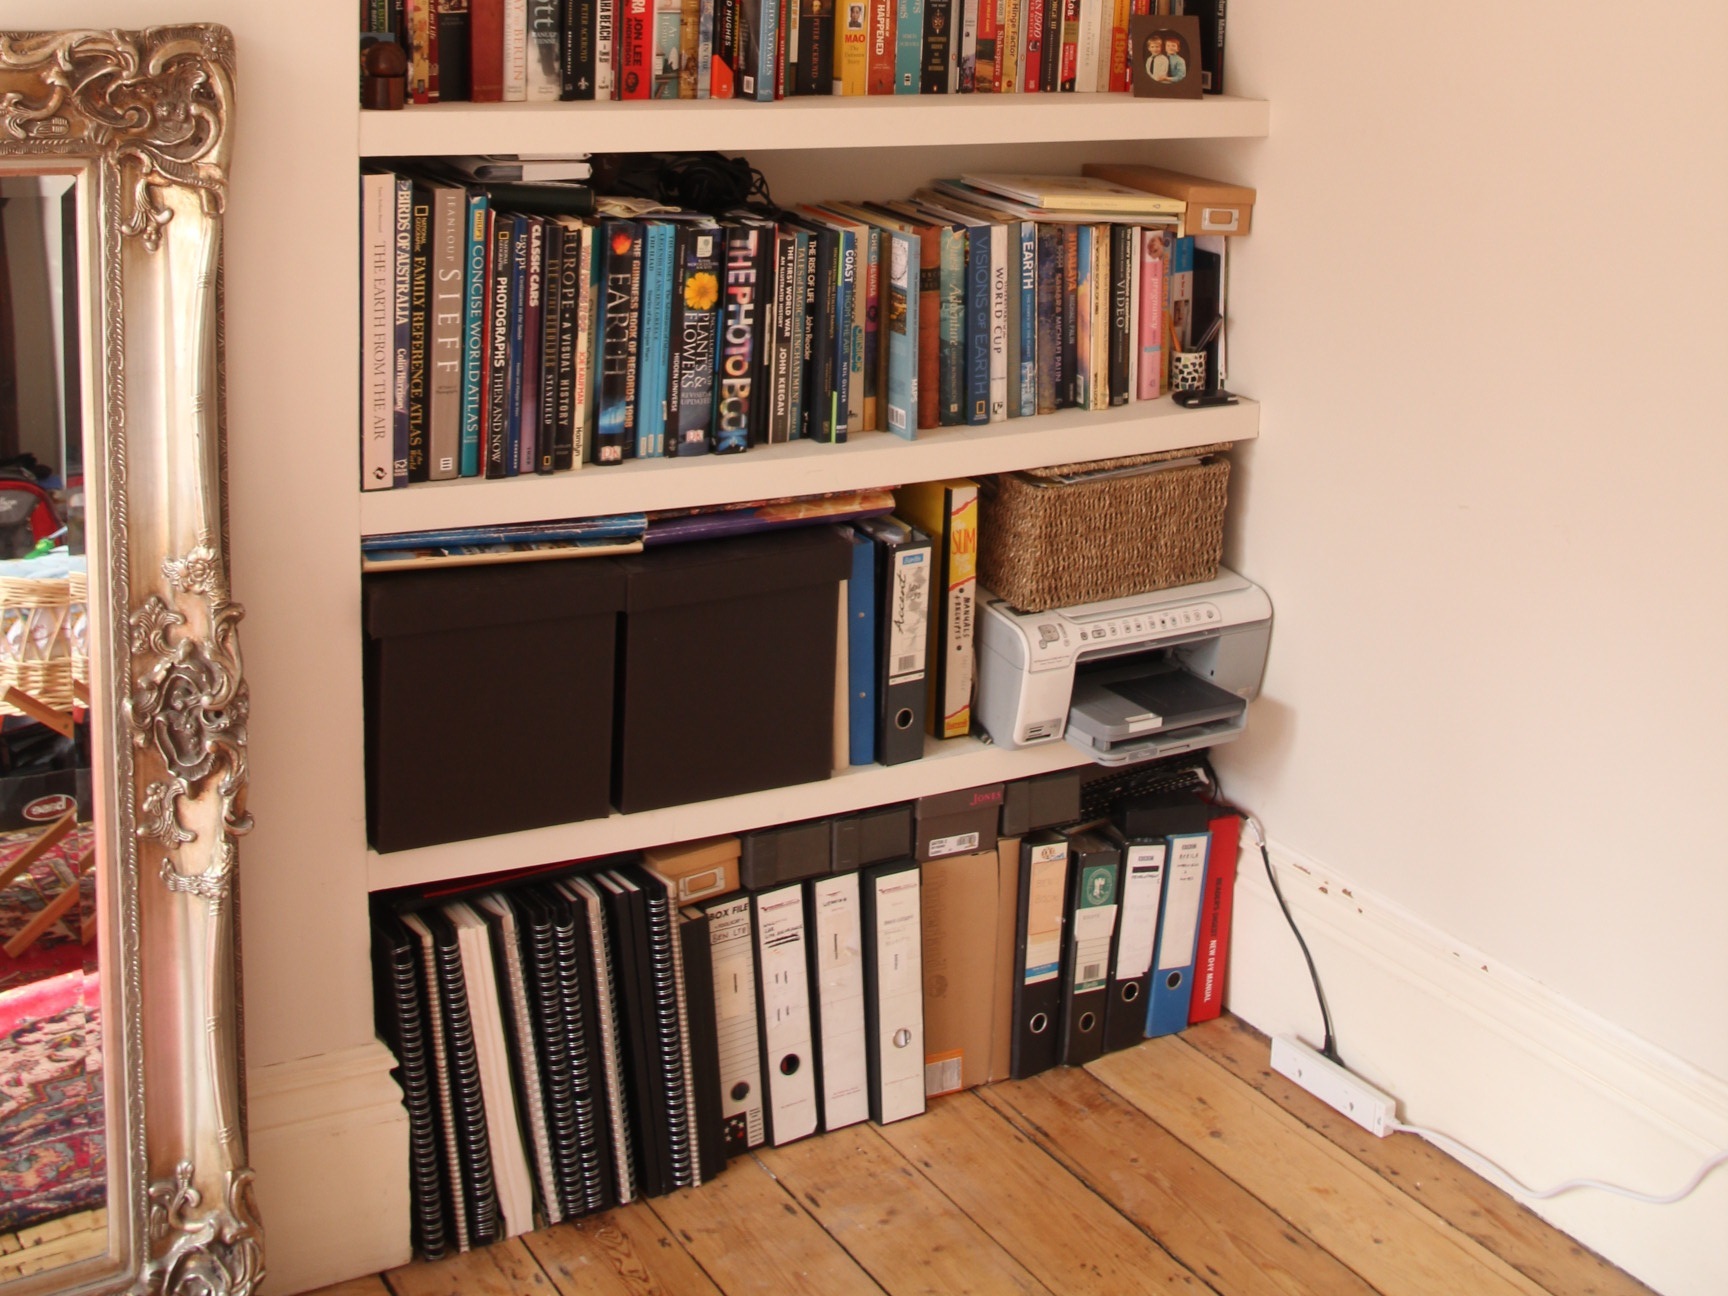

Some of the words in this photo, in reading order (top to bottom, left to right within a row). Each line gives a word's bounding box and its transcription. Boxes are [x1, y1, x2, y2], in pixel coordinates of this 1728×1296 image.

[580, 3, 589, 24] PETER
[599, 14, 612, 41] BEACH
[633, 17, 643, 40] JON
[724, 9, 733, 46] HUGHES
[876, 4, 885, 55] HAPPENED
[1009, 3, 1018, 29] Hinge
[1033, 11, 1043, 38] 1900
[580, 27, 589, 62] ACKROYD
[625, 17, 633, 66] ANDERSON
[845, 34, 866, 43] MAO
[1009, 31, 1017, 57] Factor
[1217, 19, 1225, 47] Makers
[633, 44, 642, 66] LEE
[994, 31, 1004, 76] Shakespeare
[396, 190, 410, 230] BIRDS
[396, 234, 409, 250] OF
[445, 196, 456, 262] JEANLOUP
[373, 242, 386, 274] THE
[515, 234, 527, 270] Egypt
[530, 225, 541, 273] CLASSIC
[808, 240, 817, 254] THE
[561, 231, 577, 310] EUROPE
[785, 263, 794, 284] FIRST
[807, 274, 816, 287] OF
[808, 255, 816, 273] RISE
[844, 249, 855, 283] COAST
[975, 236, 989, 309] VISIONS
[1023, 241, 1034, 289] EARTH
[395, 250, 409, 326] AUSTRALIA
[412, 256, 426, 308] FAMILY
[470, 245, 484, 318] CONCISE
[529, 274, 540, 307] CARS
[806, 288, 815, 303] LIFE
[994, 267, 1004, 319] WORLD
[373, 278, 386, 328] EARTH
[784, 286, 792, 316] WORLD
[843, 290, 852, 318] FROM
[1116, 280, 1126, 328] VIDEO
[437, 269, 461, 373] SIEFF
[494, 277, 507, 368] PHOTOGRAPHS
[604, 273, 631, 375] EARTH
[783, 318, 791, 337] WAR
[805, 315, 814, 332] John
[843, 320, 852, 337] THE
[976, 312, 986, 329] OF
[373, 333, 386, 376] FROM
[410, 311, 425, 398] REFERENCE
[468, 322, 481, 381] WORLD
[560, 334, 571, 374] VISUAL
[681, 312, 697, 388] FLOWERS
[695, 312, 709, 371] PLANTS
[804, 333, 813, 360] Reader
[842, 337, 852, 354] AIR
[993, 325, 1003, 354] CUP
[396, 348, 407, 371] Colin
[672, 353, 680, 378] HIDDEN
[778, 347, 787, 375] JOHN
[974, 334, 989, 394] EARTH
[396, 371, 406, 410] Harrison
[492, 370, 504, 401] THEN
[671, 379, 679, 412] UNIVERSE
[695, 376, 707, 388] &
[776, 377, 787, 416] KEEGAN
[910, 379, 918, 402] MAPS
[373, 380, 386, 419] THE
[467, 384, 479, 432] ATLAS
[558, 380, 570, 426] HISTORY
[373, 421, 386, 441] AIR
[409, 402, 423, 446] ATLAS
[492, 402, 503, 431] AND
[491, 434, 501, 463] NOW
[963, 597, 971, 638] MANUALS
[709, 910, 729, 921] BOX
[732, 903, 748, 915] FILE
